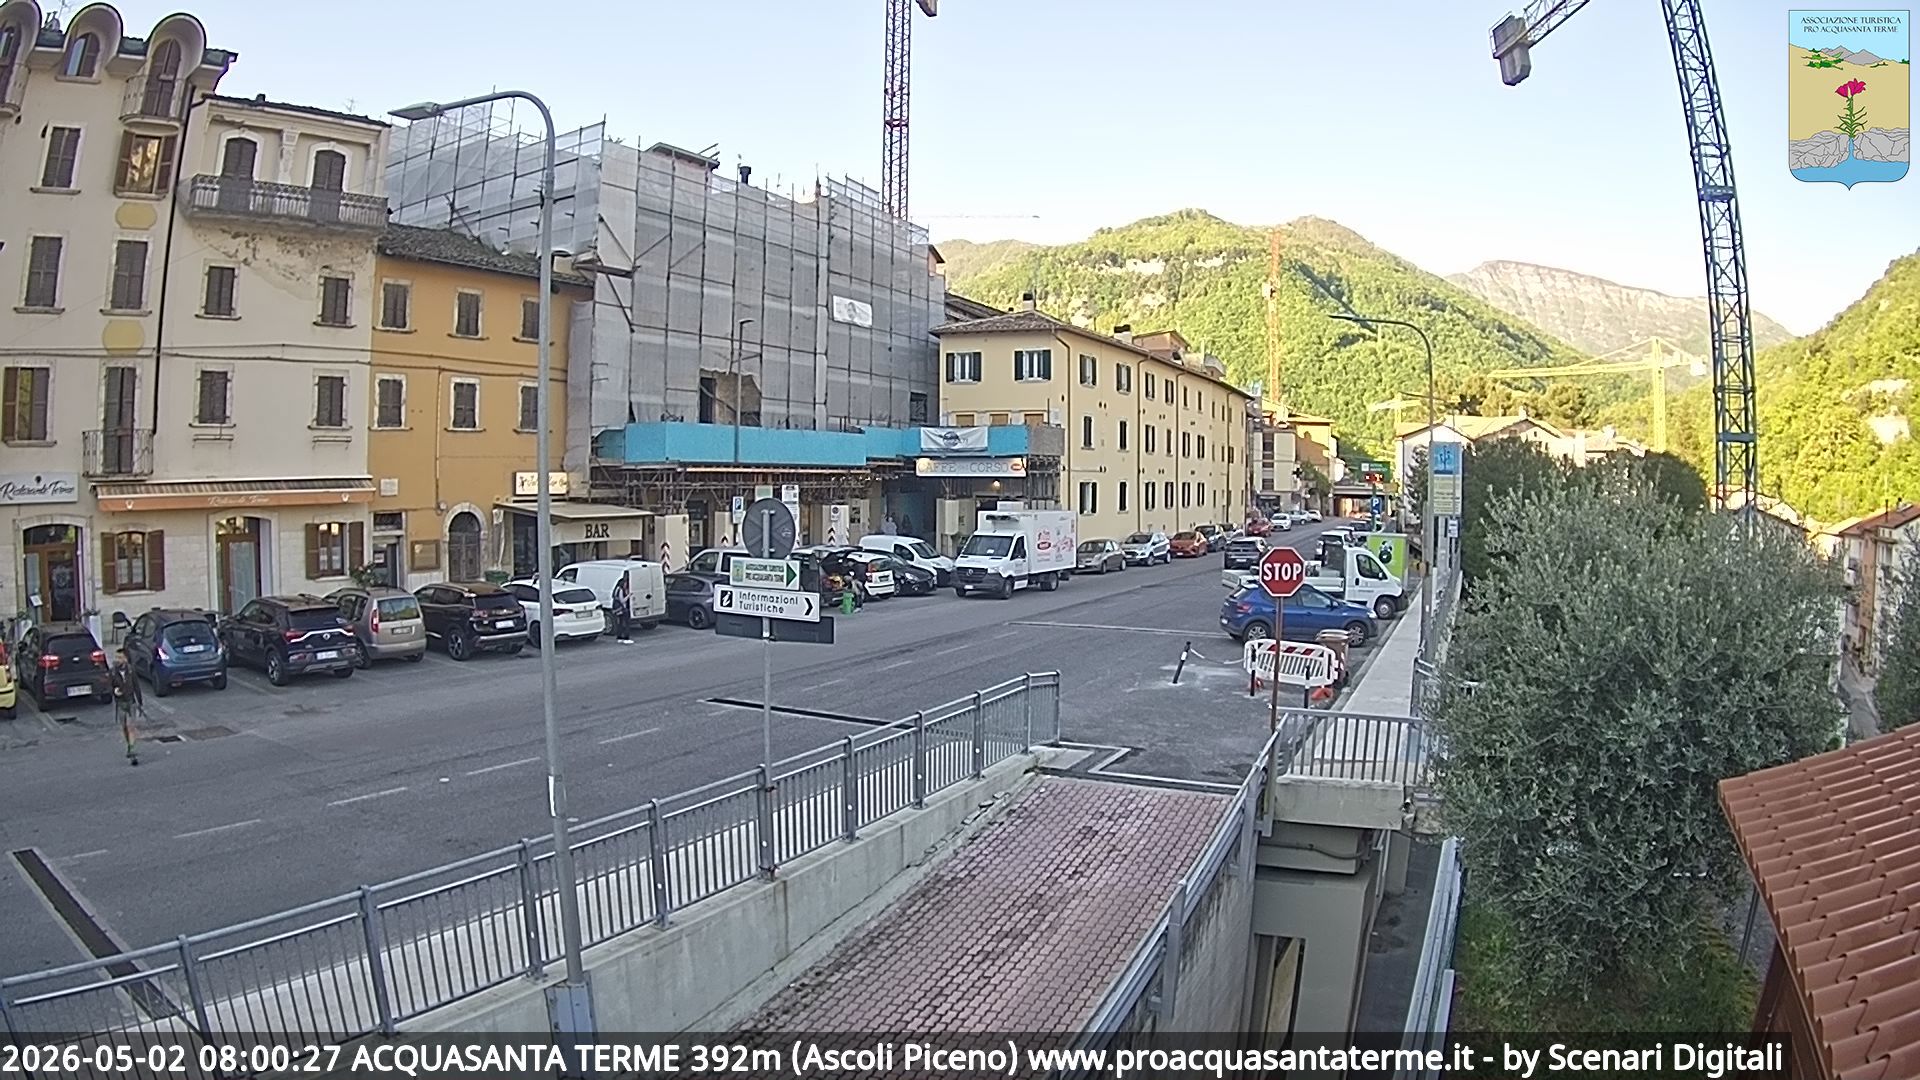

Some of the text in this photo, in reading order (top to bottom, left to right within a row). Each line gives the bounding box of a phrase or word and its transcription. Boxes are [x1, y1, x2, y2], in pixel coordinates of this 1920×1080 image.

[969, 462, 1009, 473] CORSO
[584, 523, 610, 539] BAR
[1263, 562, 1302, 581] STOP
[739, 591, 799, 605] Informazioni
[739, 601, 784, 613] Turistiche
